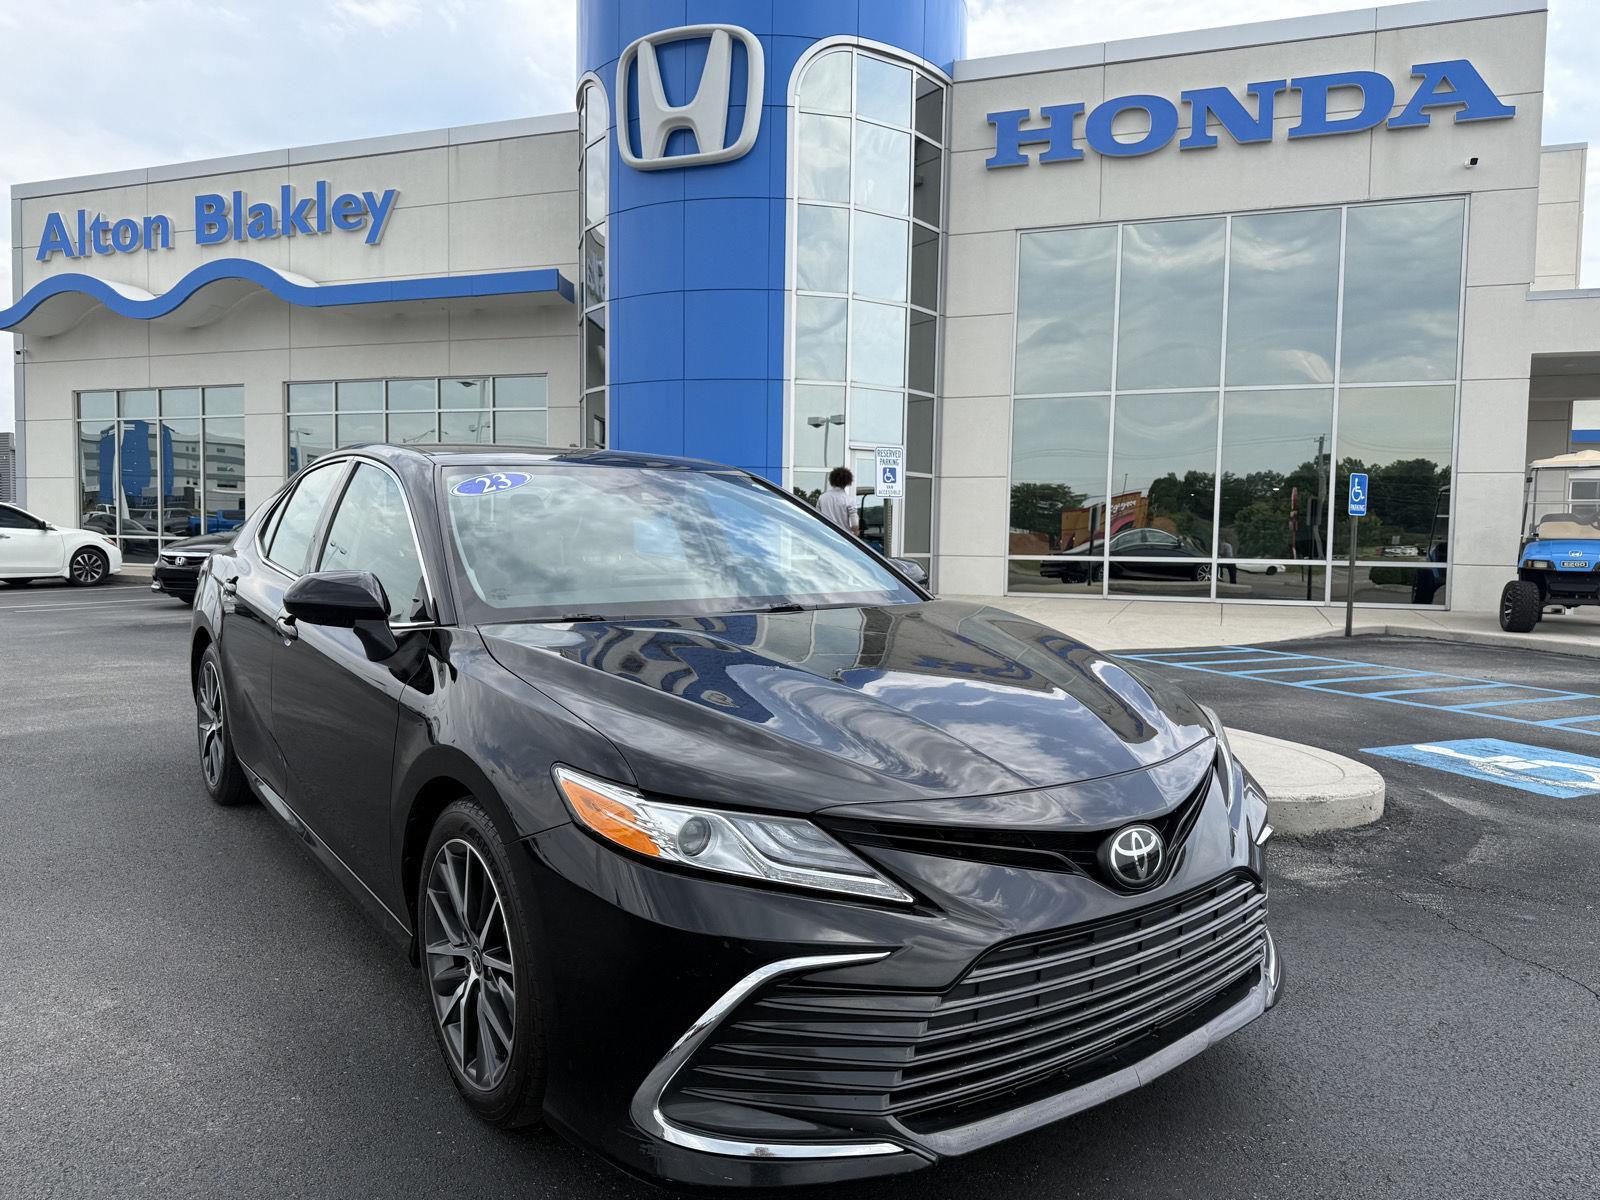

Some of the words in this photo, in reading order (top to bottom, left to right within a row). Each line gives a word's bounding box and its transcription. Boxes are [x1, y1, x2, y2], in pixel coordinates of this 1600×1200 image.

[985, 59, 1516, 170] HONDA
[36, 209, 175, 262] Alton
[194, 180, 400, 246] Blakley
[877, 449, 901, 457] RESERVED
[475, 473, 512, 493] 23
